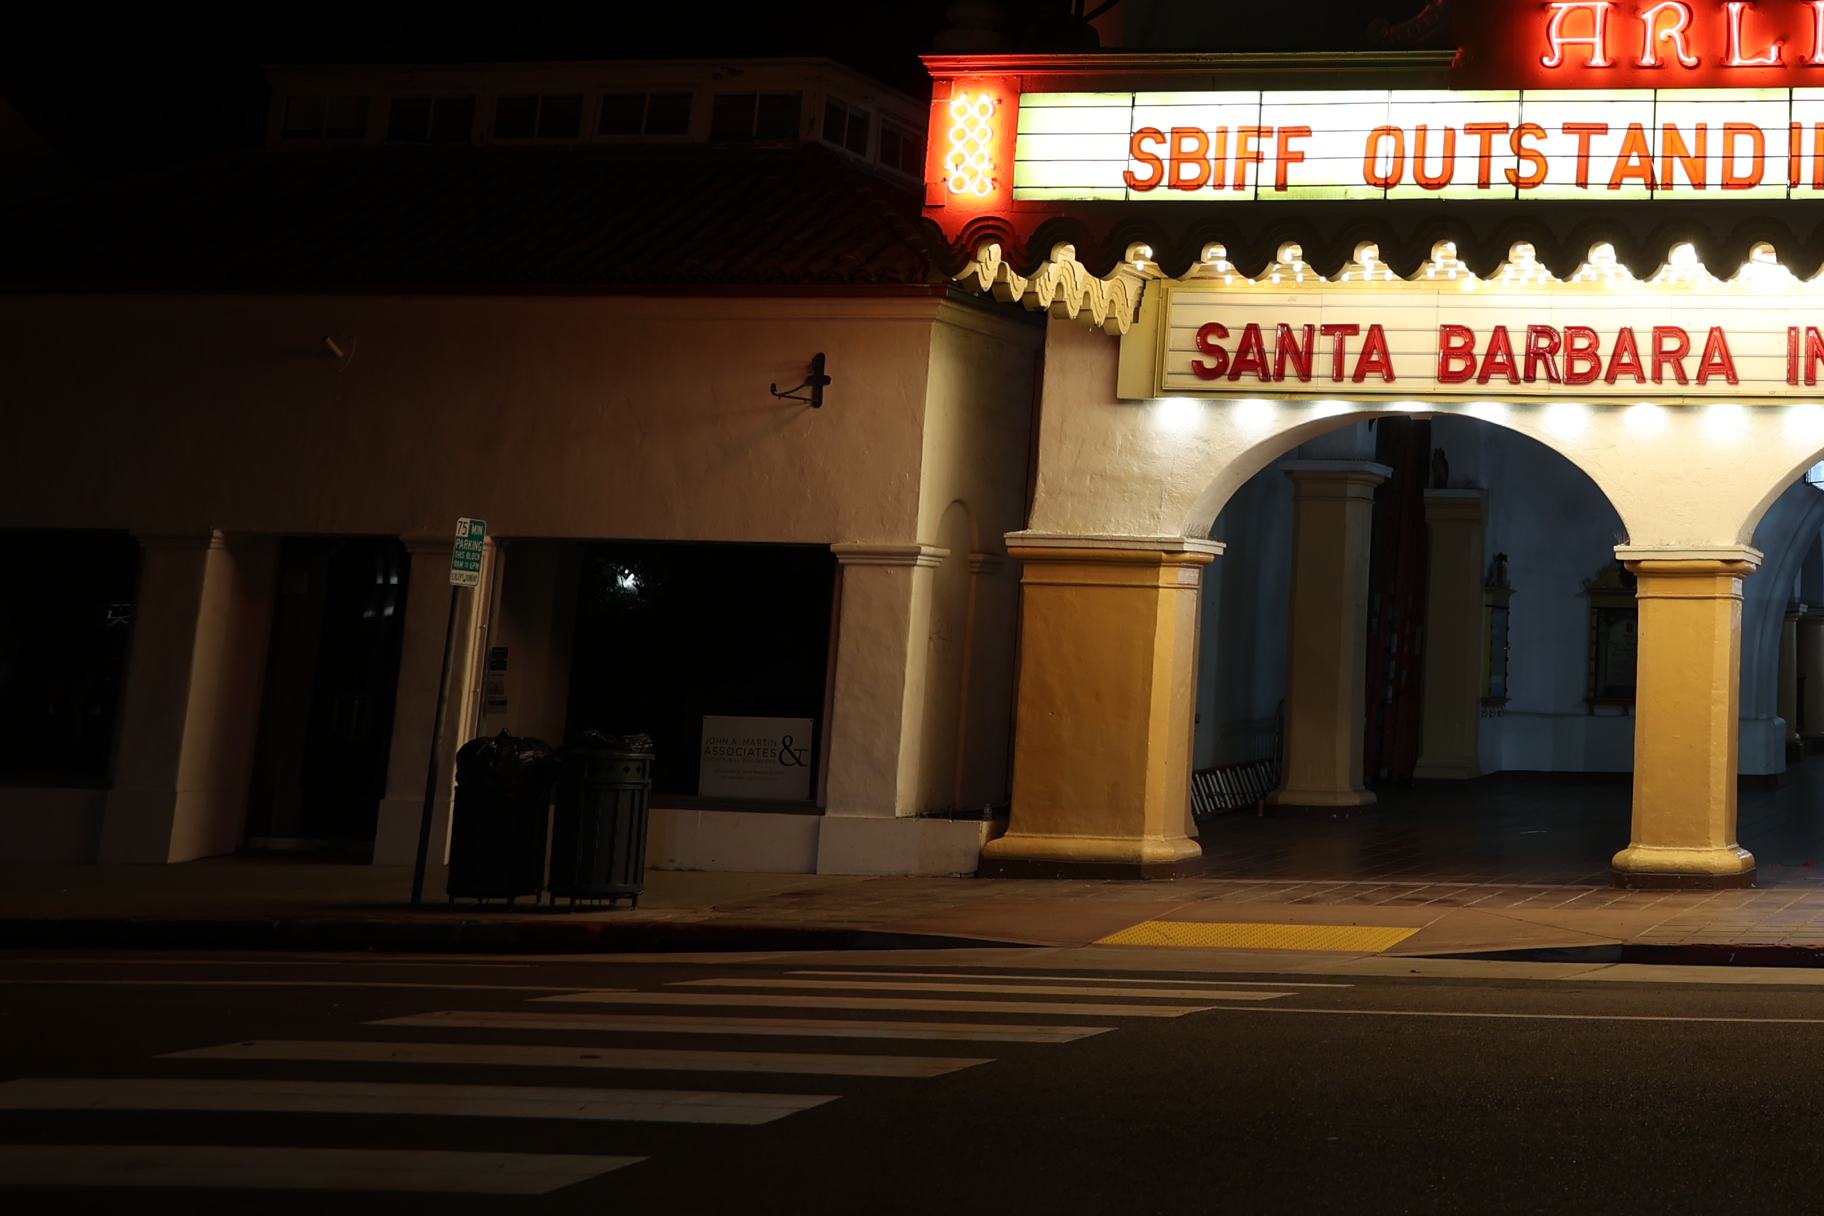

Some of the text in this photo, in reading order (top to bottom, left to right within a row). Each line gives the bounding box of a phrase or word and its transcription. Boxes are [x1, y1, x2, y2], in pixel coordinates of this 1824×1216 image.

[1124, 125, 1312, 192] SBIFF
[1189, 322, 1397, 384] SANTA
[1436, 324, 1738, 385] BARBARA
[457, 521, 484, 535] 75 MIN
[455, 538, 483, 551] PARKING
[454, 550, 481, 561] THIS BLOCK
[704, 737, 728, 745] JOHN
[743, 738, 777, 747] MARTIN
[703, 746, 777, 758] ASSOCIATES
[779, 735, 808, 767] &
